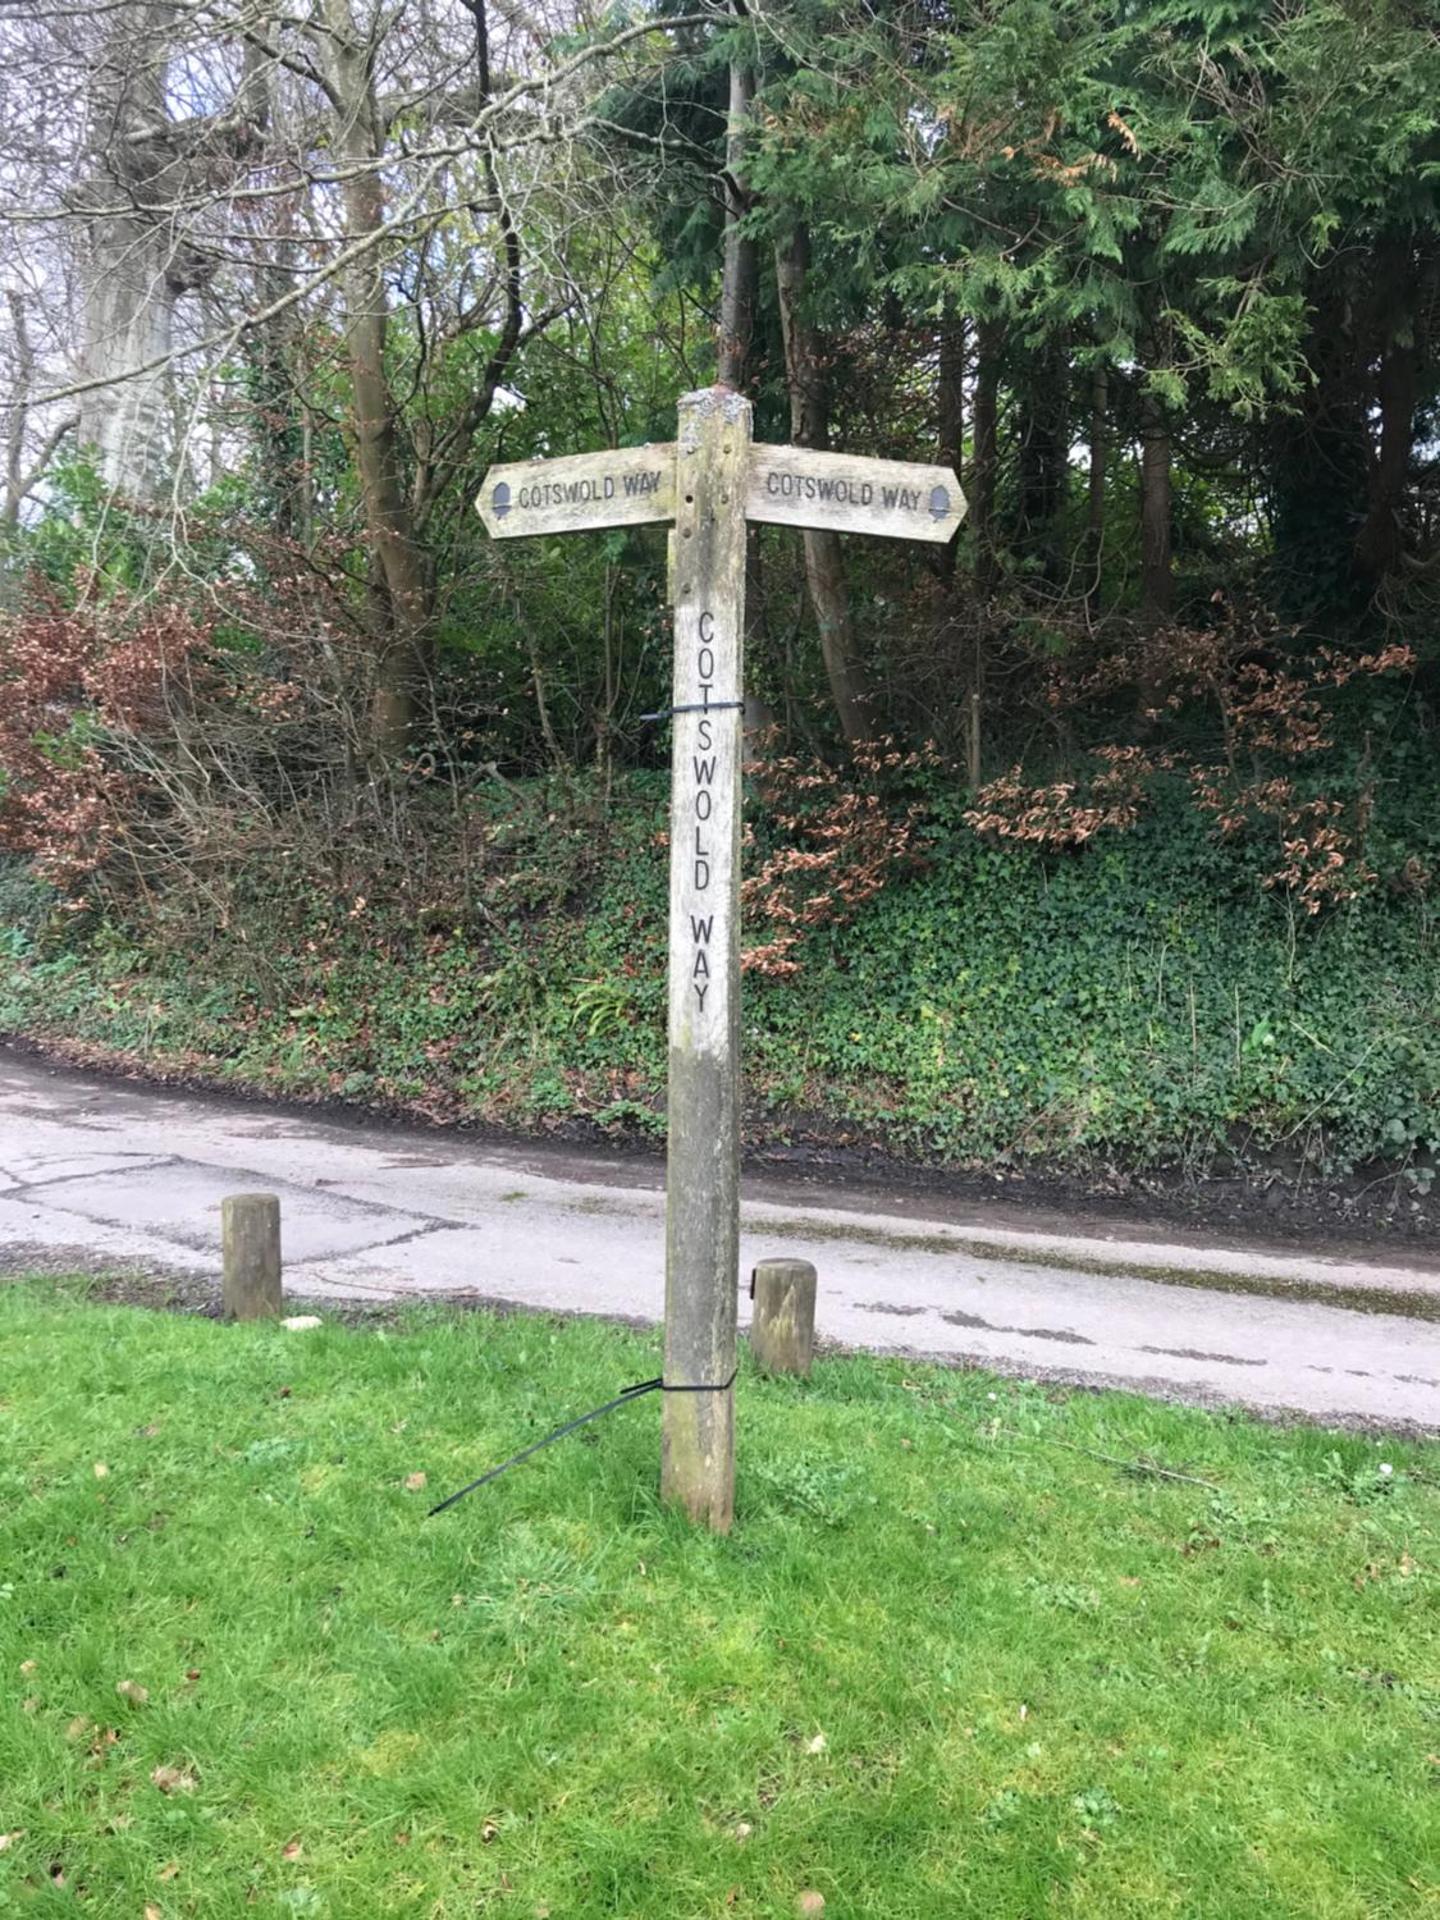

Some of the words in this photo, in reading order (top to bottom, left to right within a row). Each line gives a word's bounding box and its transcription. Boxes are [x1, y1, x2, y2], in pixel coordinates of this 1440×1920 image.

[518, 476, 615, 509] COTSWOLD
[623, 470, 662, 496] WAY
[767, 471, 873, 506] COTSWOLD
[881, 486, 922, 511] WAY
[693, 611, 717, 891] COTSWOLD
[690, 914, 714, 1013] WAY
